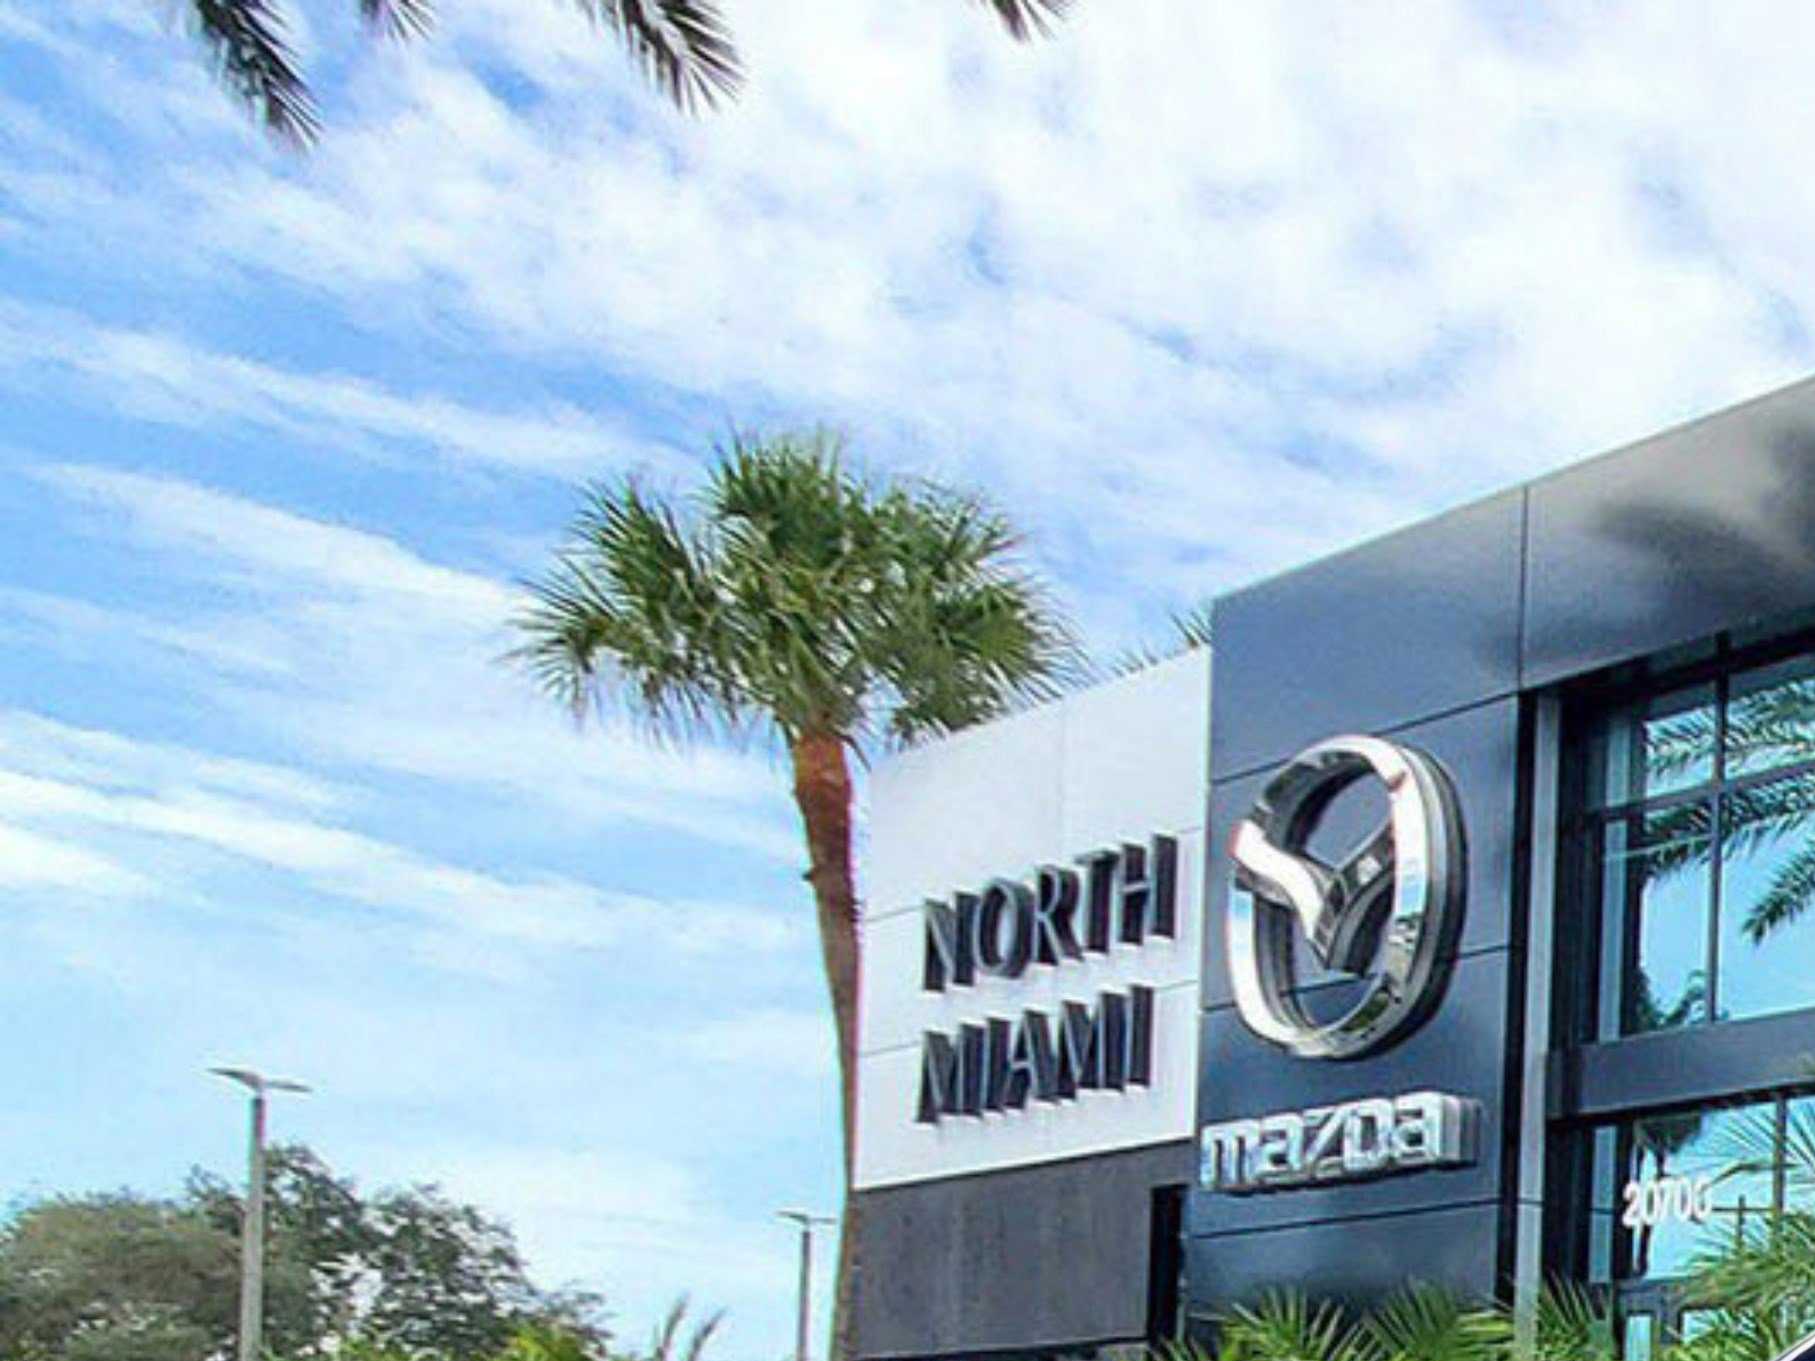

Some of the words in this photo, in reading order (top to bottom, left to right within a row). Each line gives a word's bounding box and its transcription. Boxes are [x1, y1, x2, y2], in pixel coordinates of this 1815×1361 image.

[922, 833, 1178, 993] NORTH
[916, 983, 1154, 1124] MIAMI
[1200, 1090, 1470, 1192] mazda
